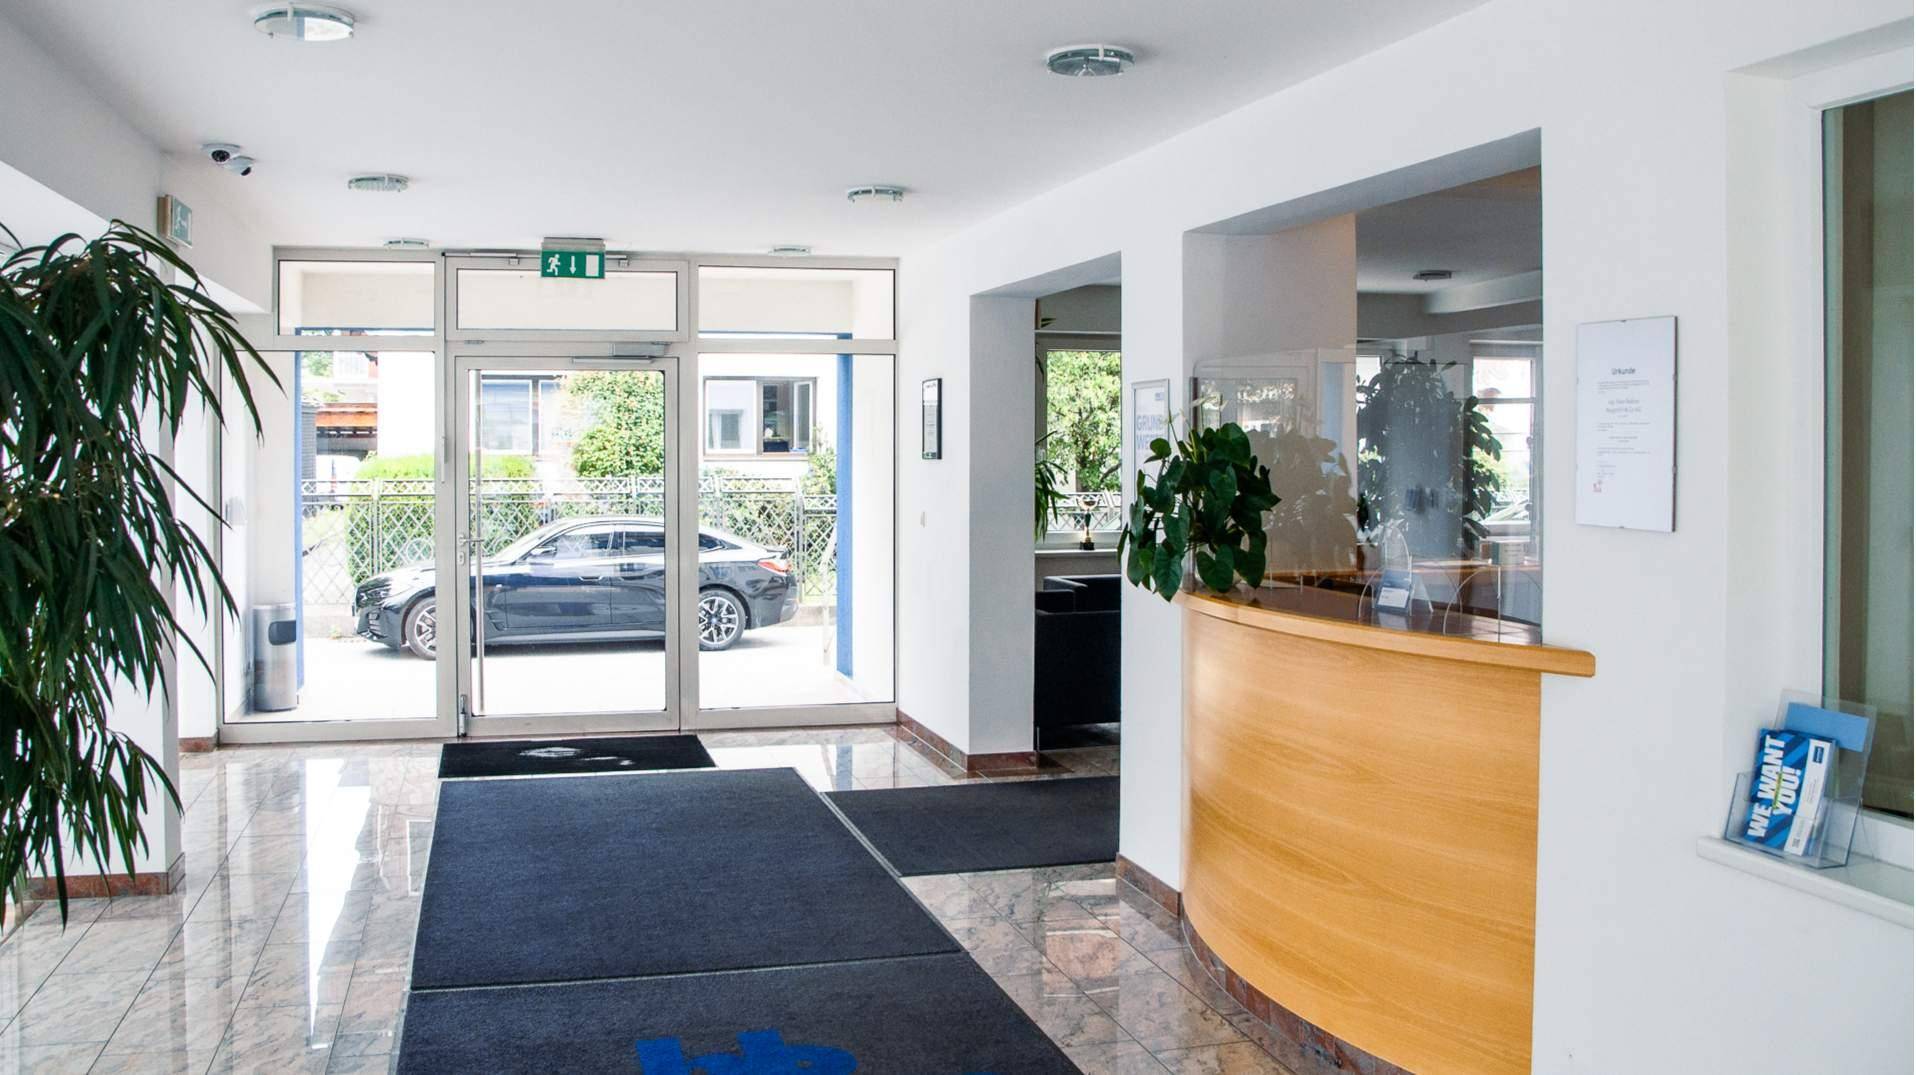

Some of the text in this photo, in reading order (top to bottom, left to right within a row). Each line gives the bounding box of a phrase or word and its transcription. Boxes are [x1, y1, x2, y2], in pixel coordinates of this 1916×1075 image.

[1611, 367, 1636, 376] Urkunde
[1747, 735, 1786, 838] WE WANT
[1773, 766, 1802, 816] YOU!
